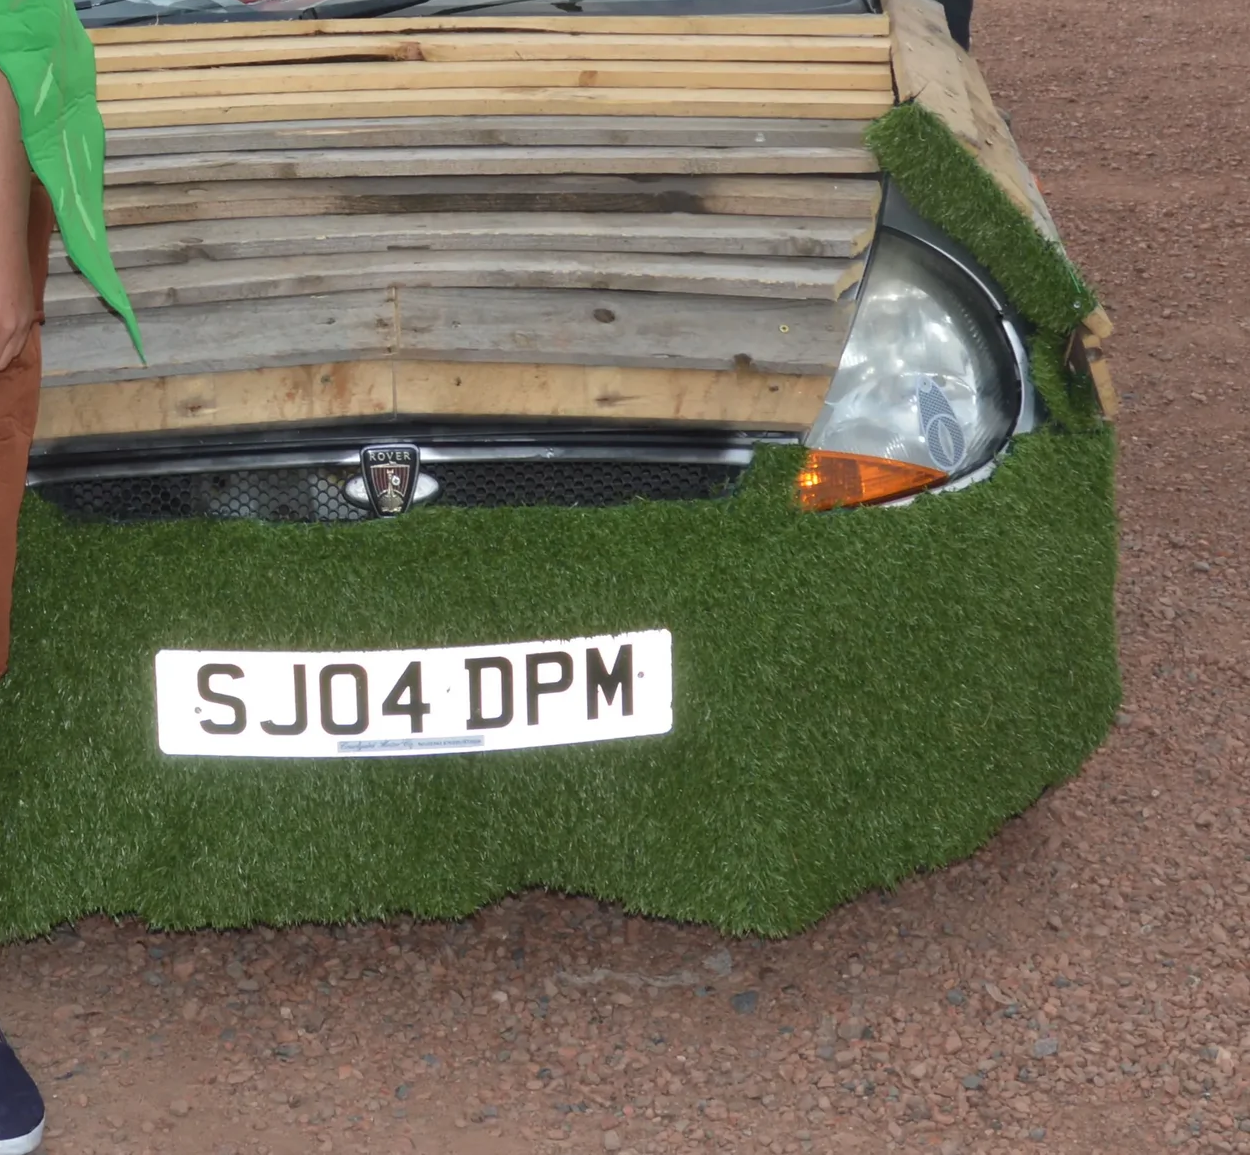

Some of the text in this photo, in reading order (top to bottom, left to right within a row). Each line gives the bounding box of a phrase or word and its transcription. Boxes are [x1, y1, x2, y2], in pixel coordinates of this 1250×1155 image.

[369, 451, 412, 462] ROVER
[196, 643, 635, 736] SJ04 DPM
